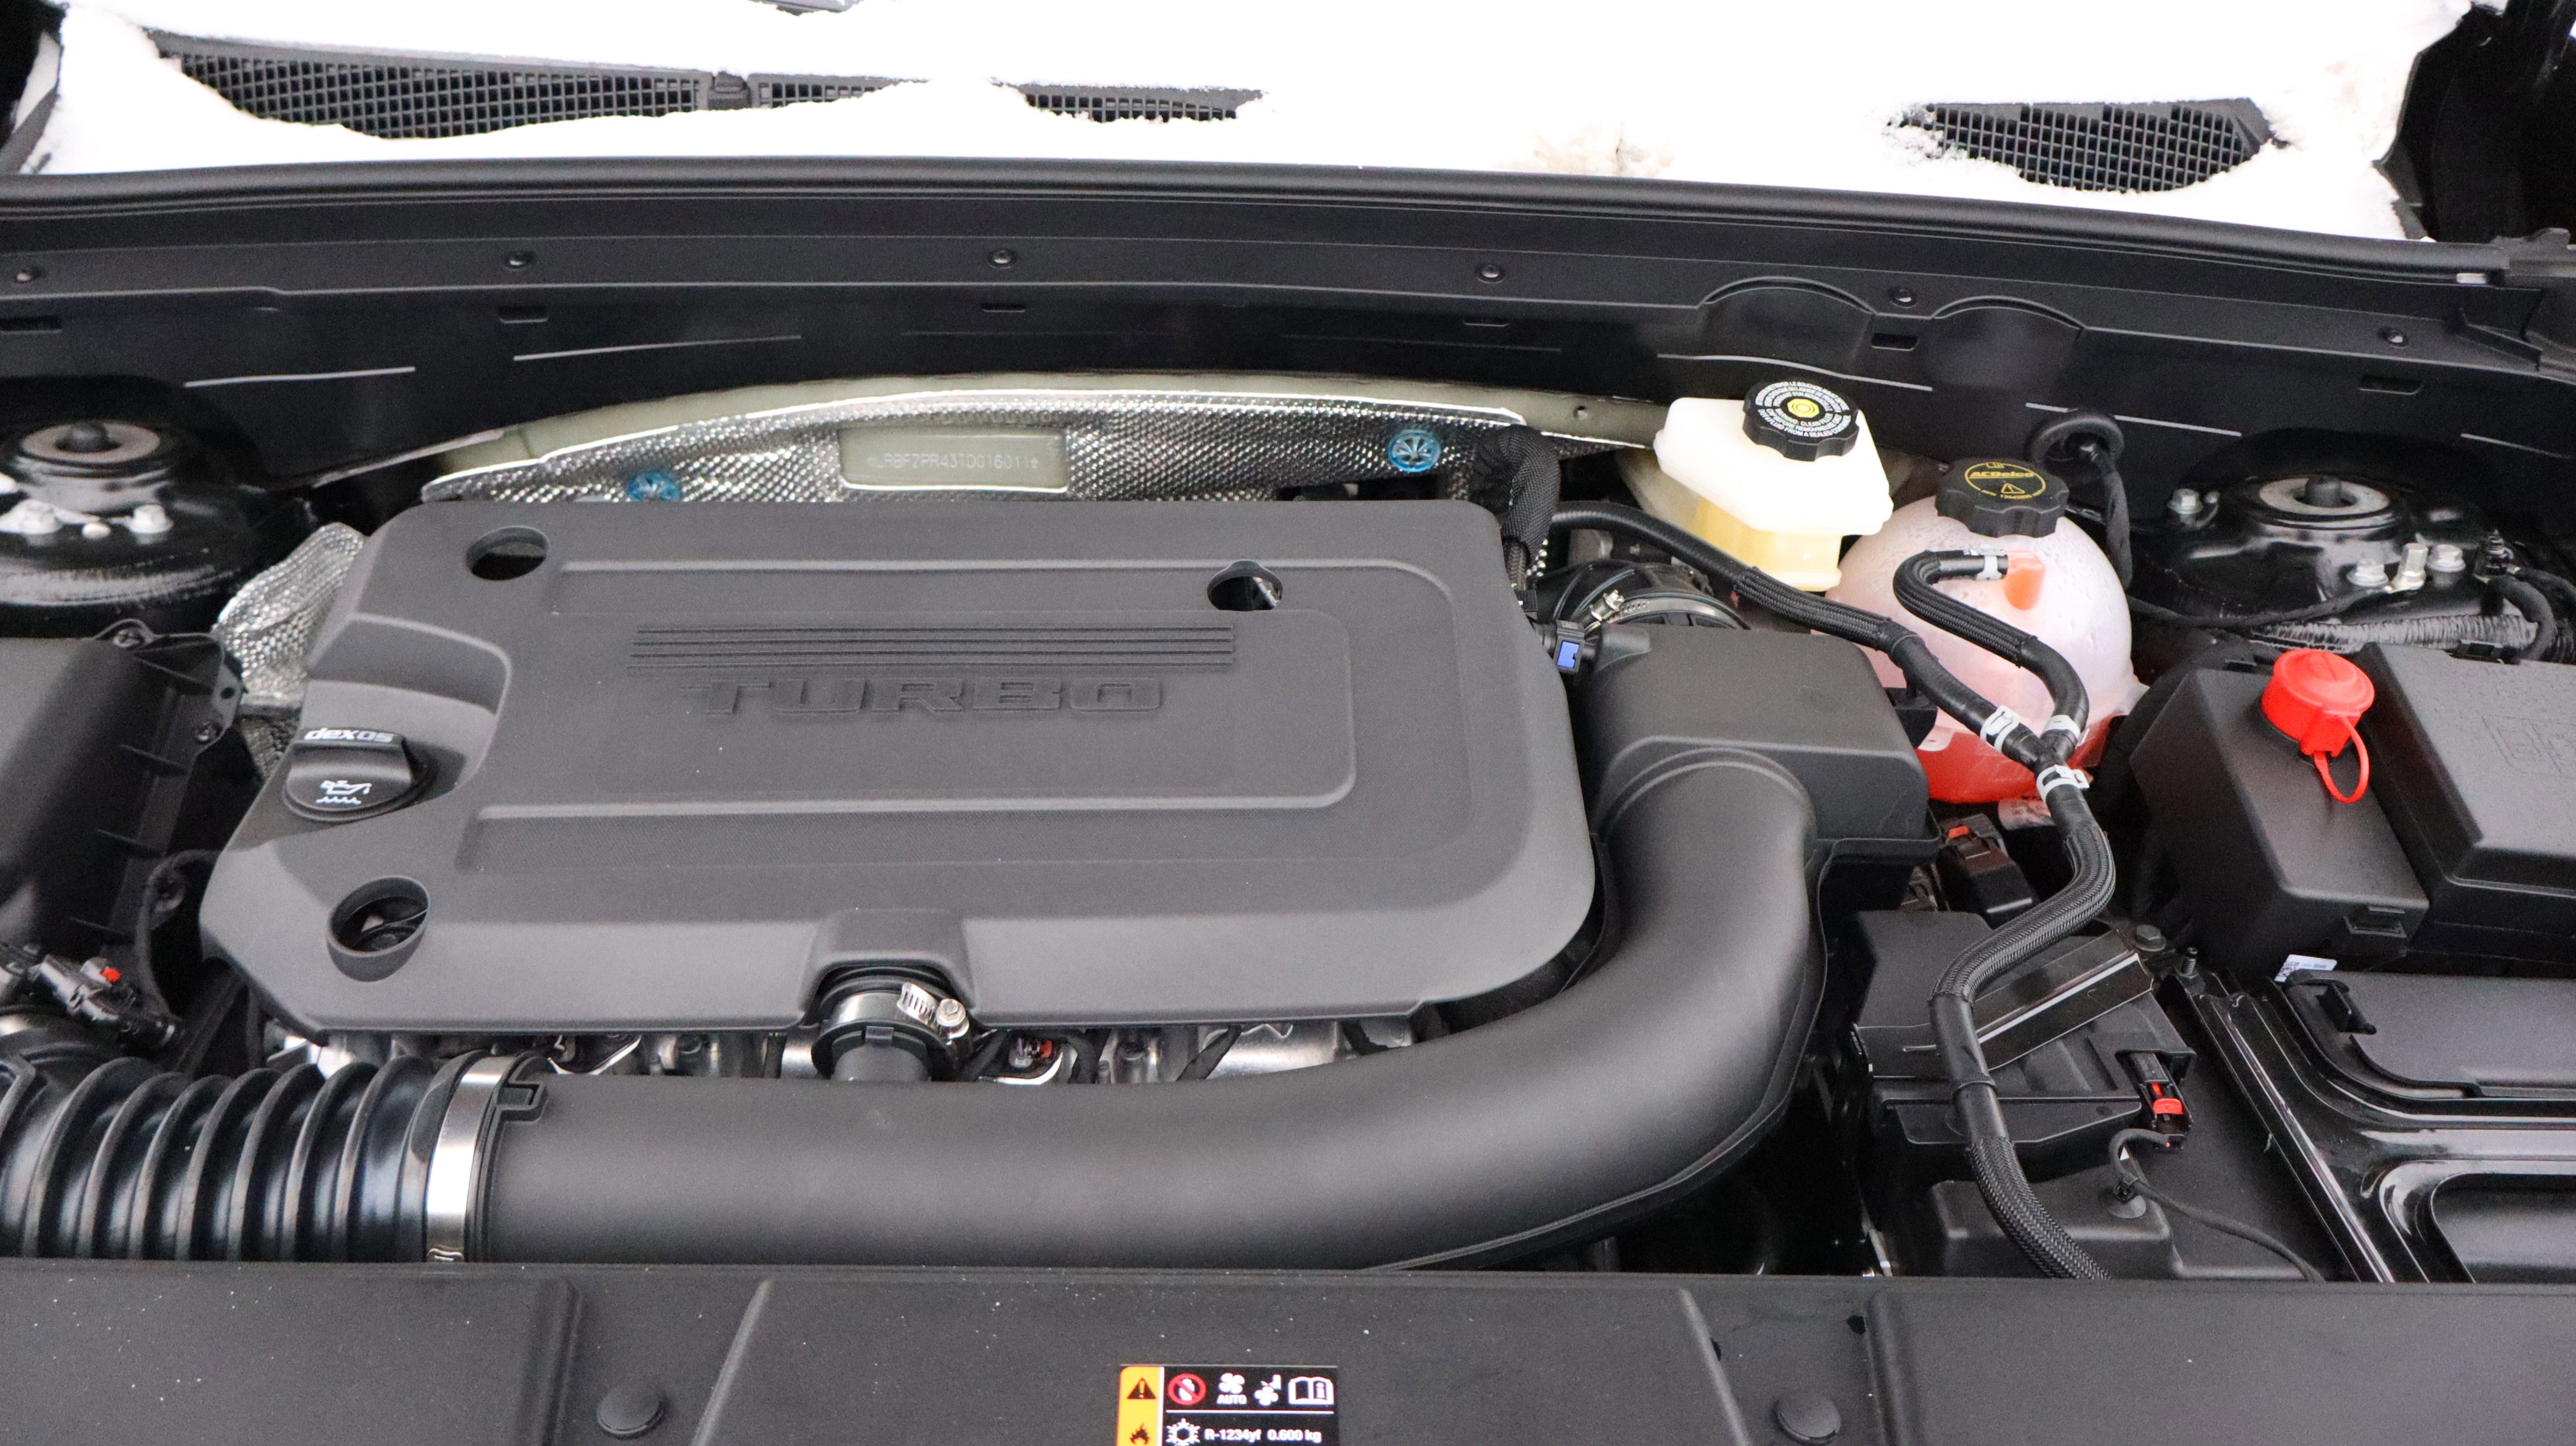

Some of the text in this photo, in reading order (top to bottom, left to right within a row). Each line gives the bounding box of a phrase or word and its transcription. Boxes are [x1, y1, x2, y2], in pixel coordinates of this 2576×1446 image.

[1784, 427, 1803, 436] FROM
[1809, 430, 1833, 438] SEALED
[679, 676, 1163, 716] TURBO
[304, 727, 395, 743] dexos
[1216, 1394, 1247, 1405] AUTO
[1204, 1429, 1322, 1443] R-1234yf 0.600 kg
